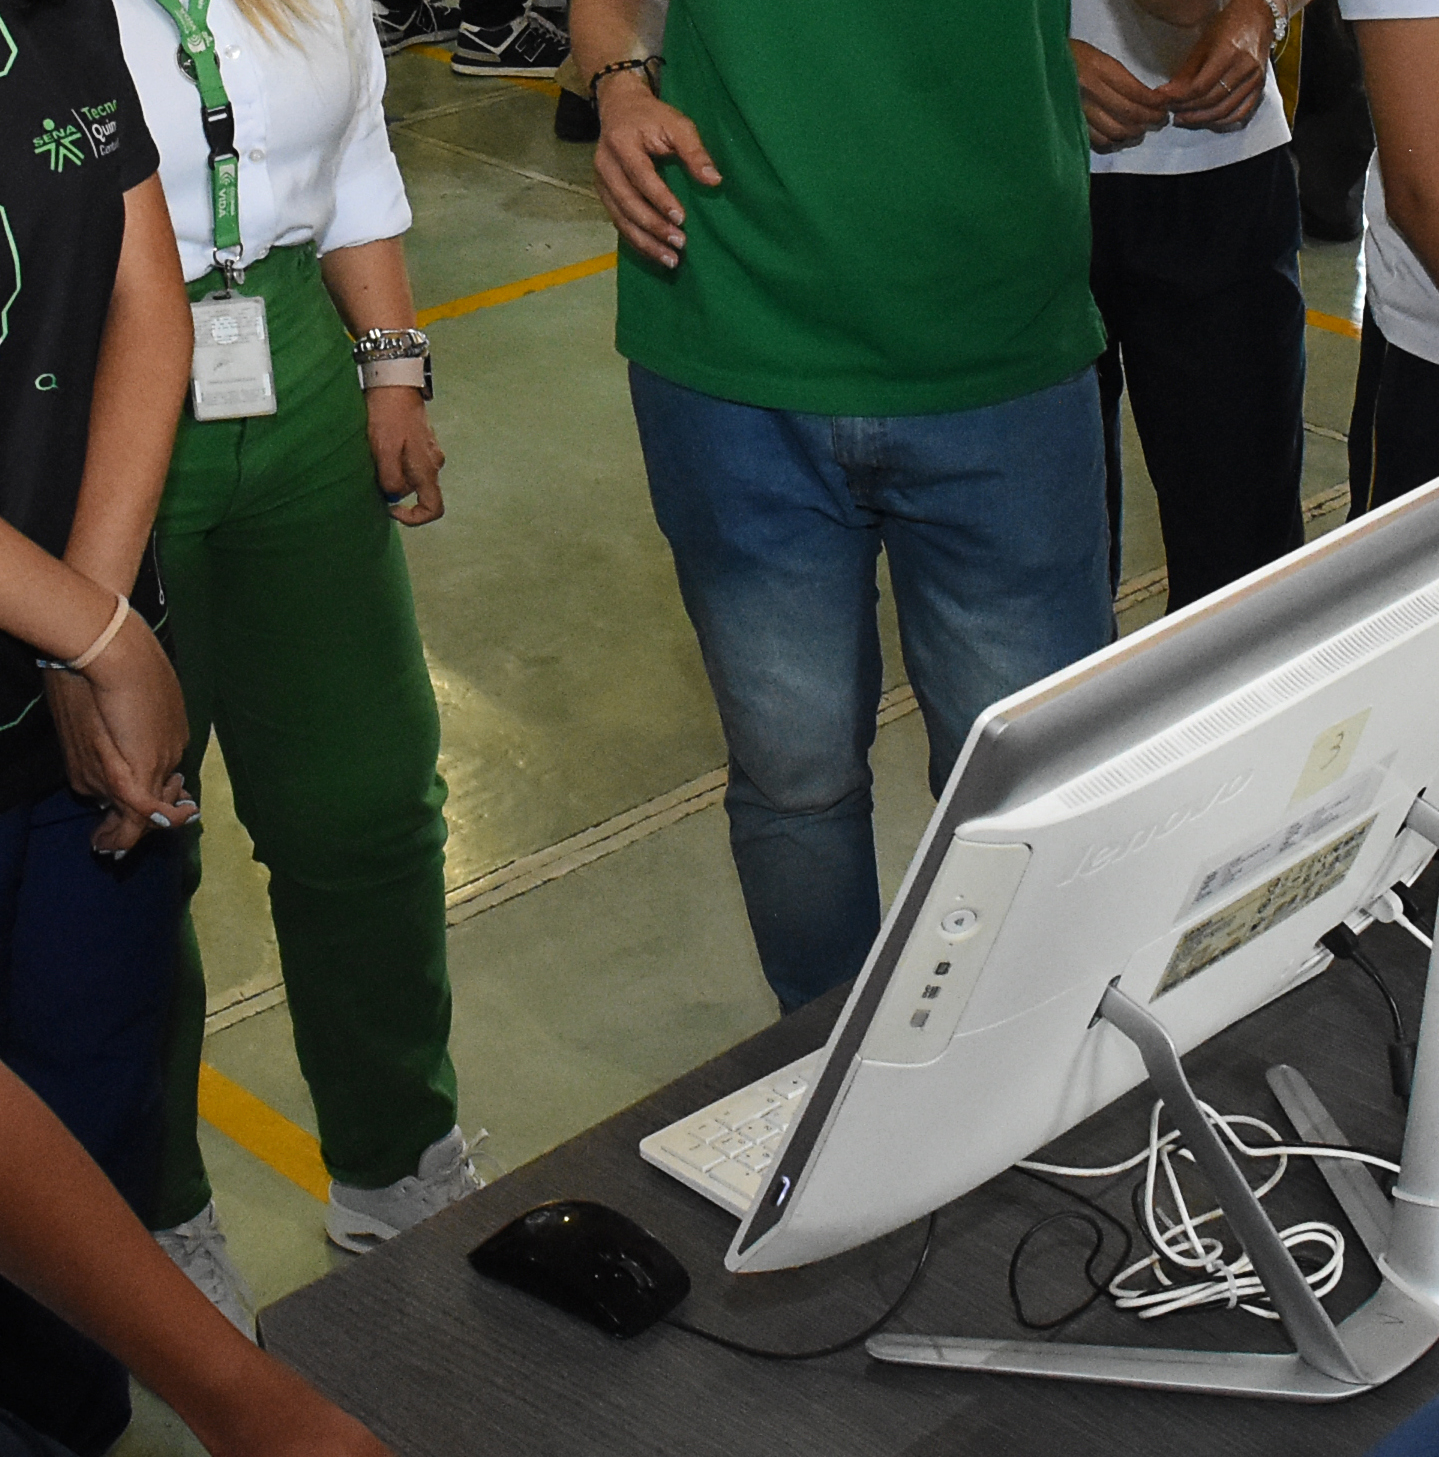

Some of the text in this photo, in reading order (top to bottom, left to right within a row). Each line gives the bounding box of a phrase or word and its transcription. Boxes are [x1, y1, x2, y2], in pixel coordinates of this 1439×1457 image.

[33, 125, 78, 147] SENA
[218, 188, 227, 219] VIDA
[1056, 769, 1255, 888] lenovo
